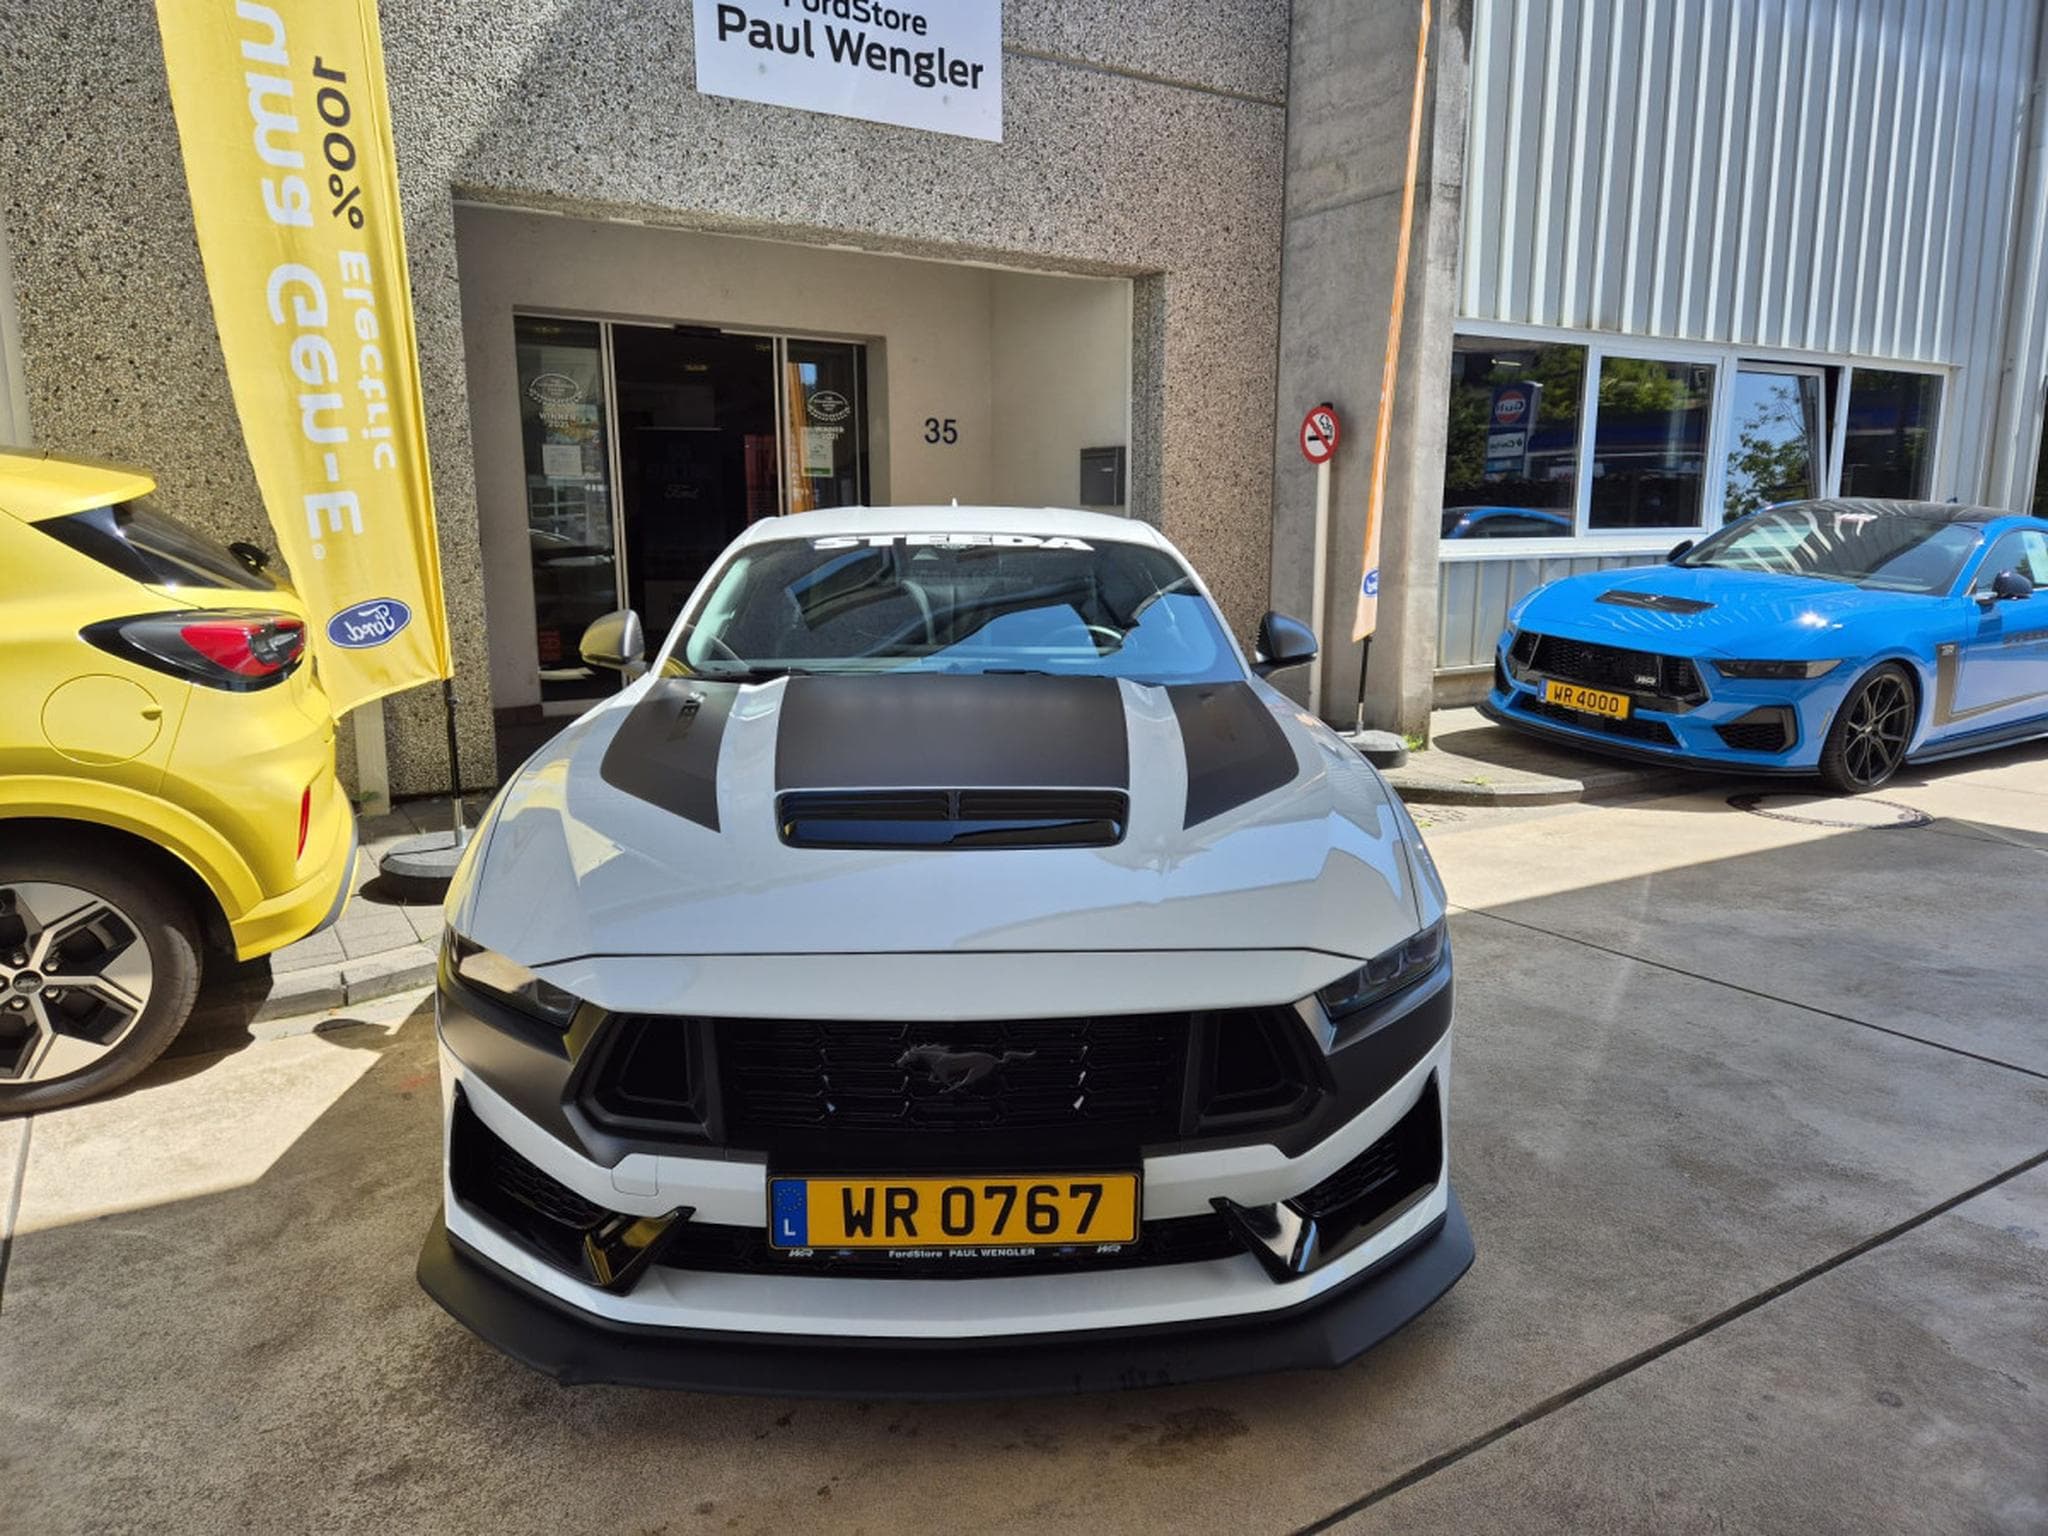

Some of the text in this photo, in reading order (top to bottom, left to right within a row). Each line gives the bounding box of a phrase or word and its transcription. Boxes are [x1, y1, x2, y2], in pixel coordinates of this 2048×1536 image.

[783, 0, 928, 36] ordStore
[716, 3, 985, 89] Paul Wengler
[924, 417, 958, 444] 35
[1553, 685, 1574, 704] WR
[1576, 689, 1620, 714] 4000
[841, 1183, 1104, 1239] WR 0767
[783, 1218, 797, 1237] L
[888, 1247, 1036, 1259] FordStore PAUL WENGLER
